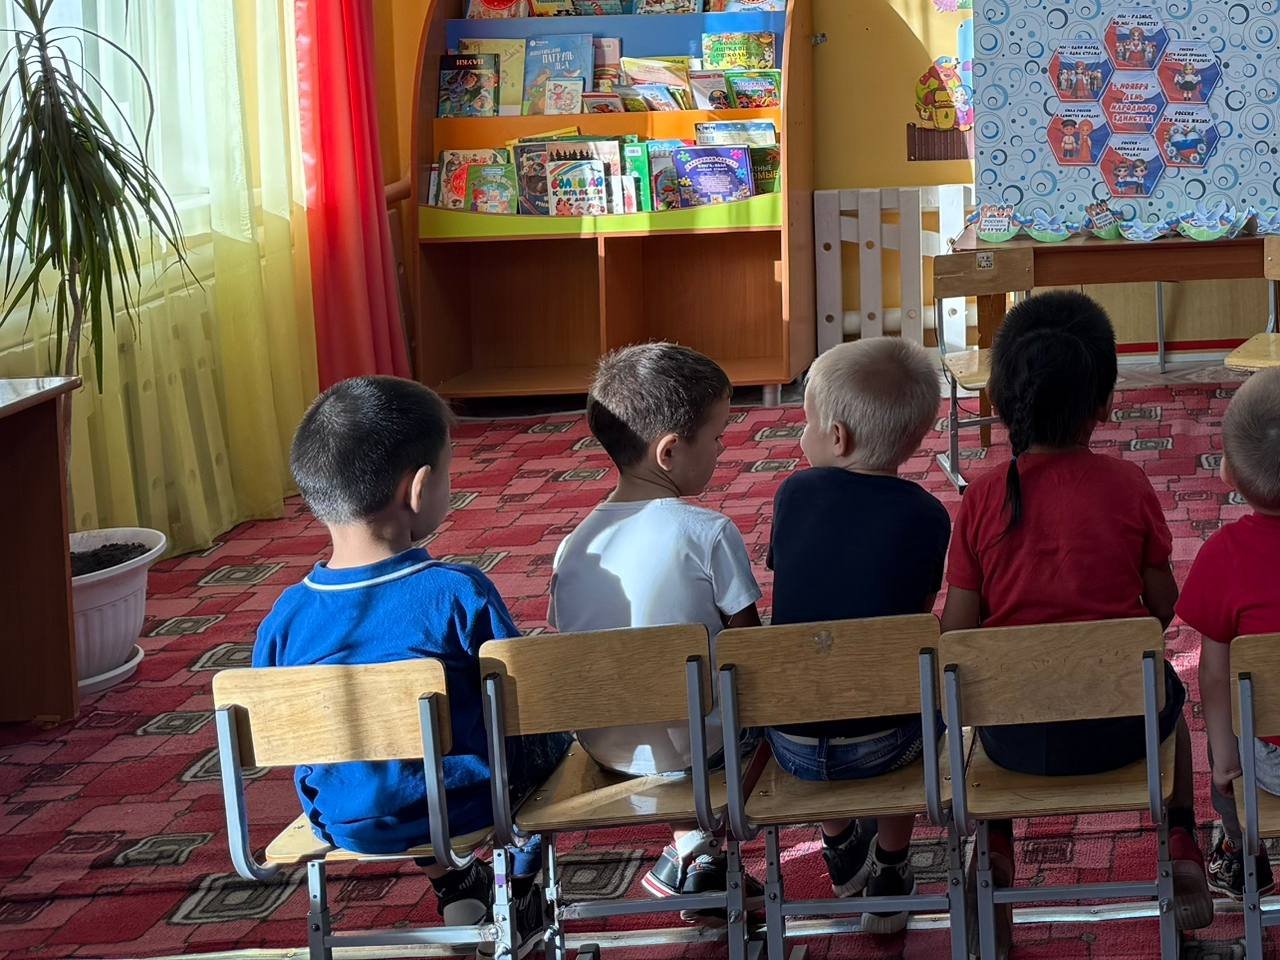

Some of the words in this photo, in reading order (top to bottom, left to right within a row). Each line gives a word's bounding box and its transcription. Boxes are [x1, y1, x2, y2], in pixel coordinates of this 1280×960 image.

[1119, 82, 1149, 90] НОЯБРЯ
[1123, 93, 1144, 102] ДЕНЬ
[1110, 103, 1157, 112] НАРОДНОГО
[1113, 114, 1153, 123] ЕДИНСТВА
[551, 175, 604, 190] БОЛЬШАЯ
